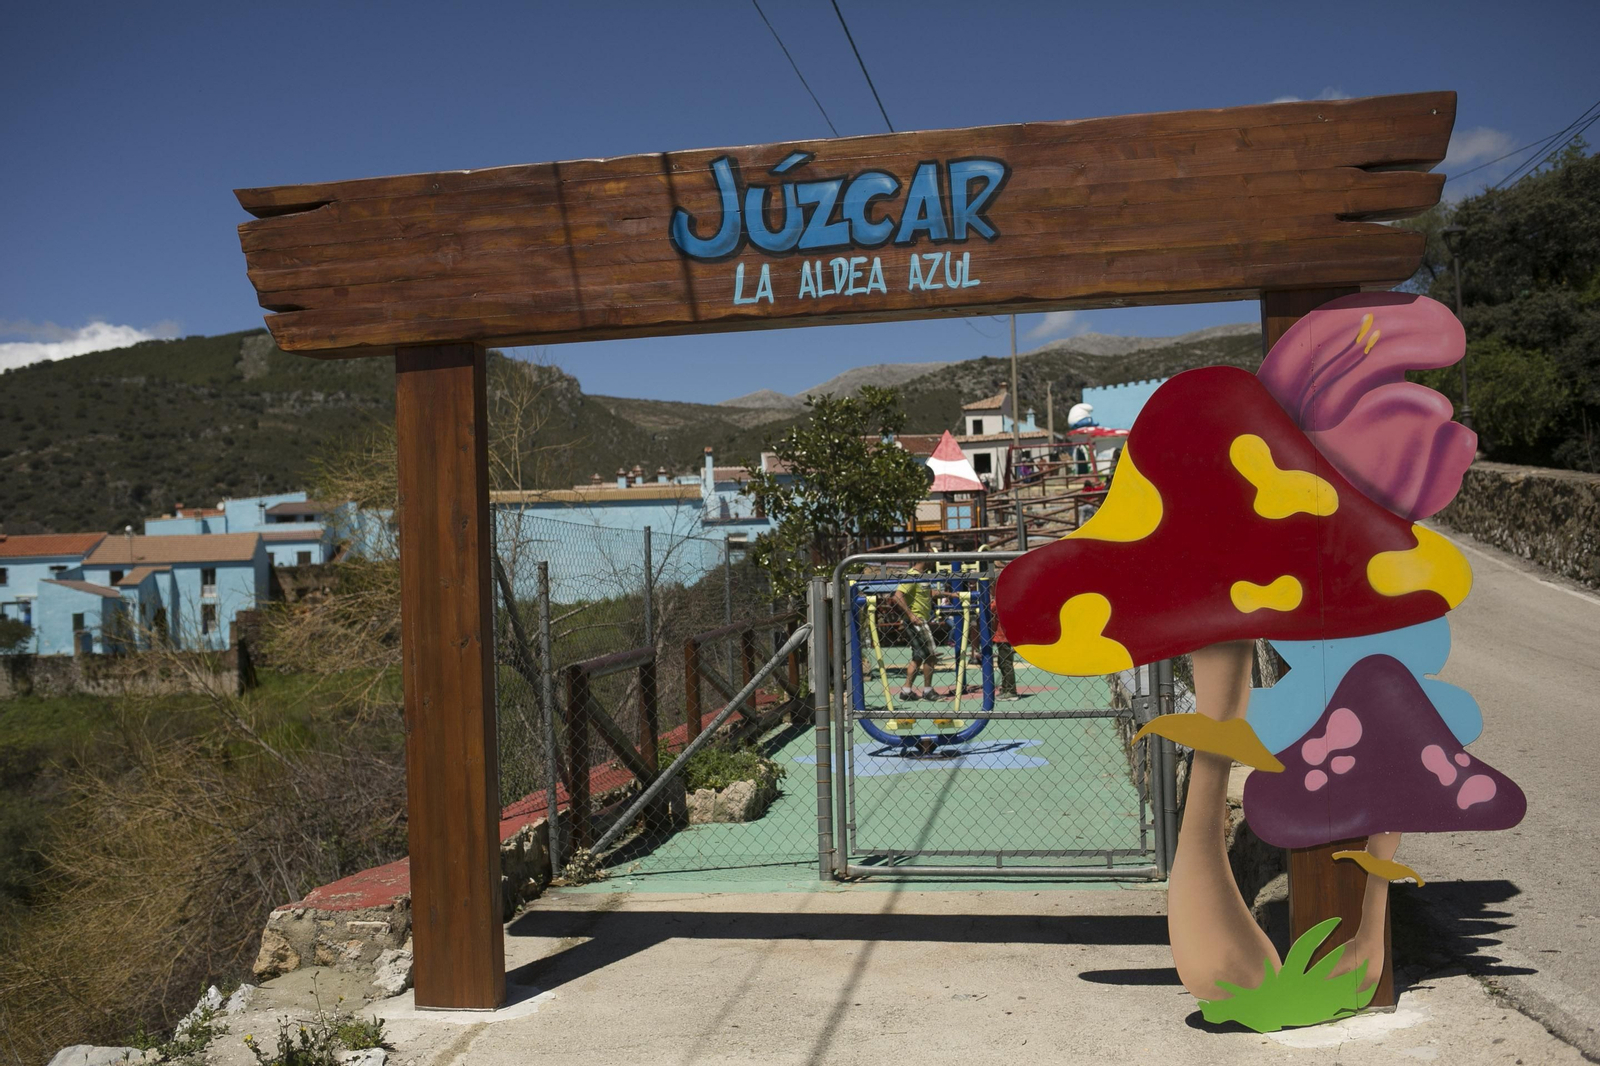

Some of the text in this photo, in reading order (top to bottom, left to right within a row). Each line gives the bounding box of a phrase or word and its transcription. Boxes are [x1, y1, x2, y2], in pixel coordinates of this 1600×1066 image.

[670, 151, 1011, 262] JÚZCAR
[733, 251, 981, 304] LA ALDEA AZUL
